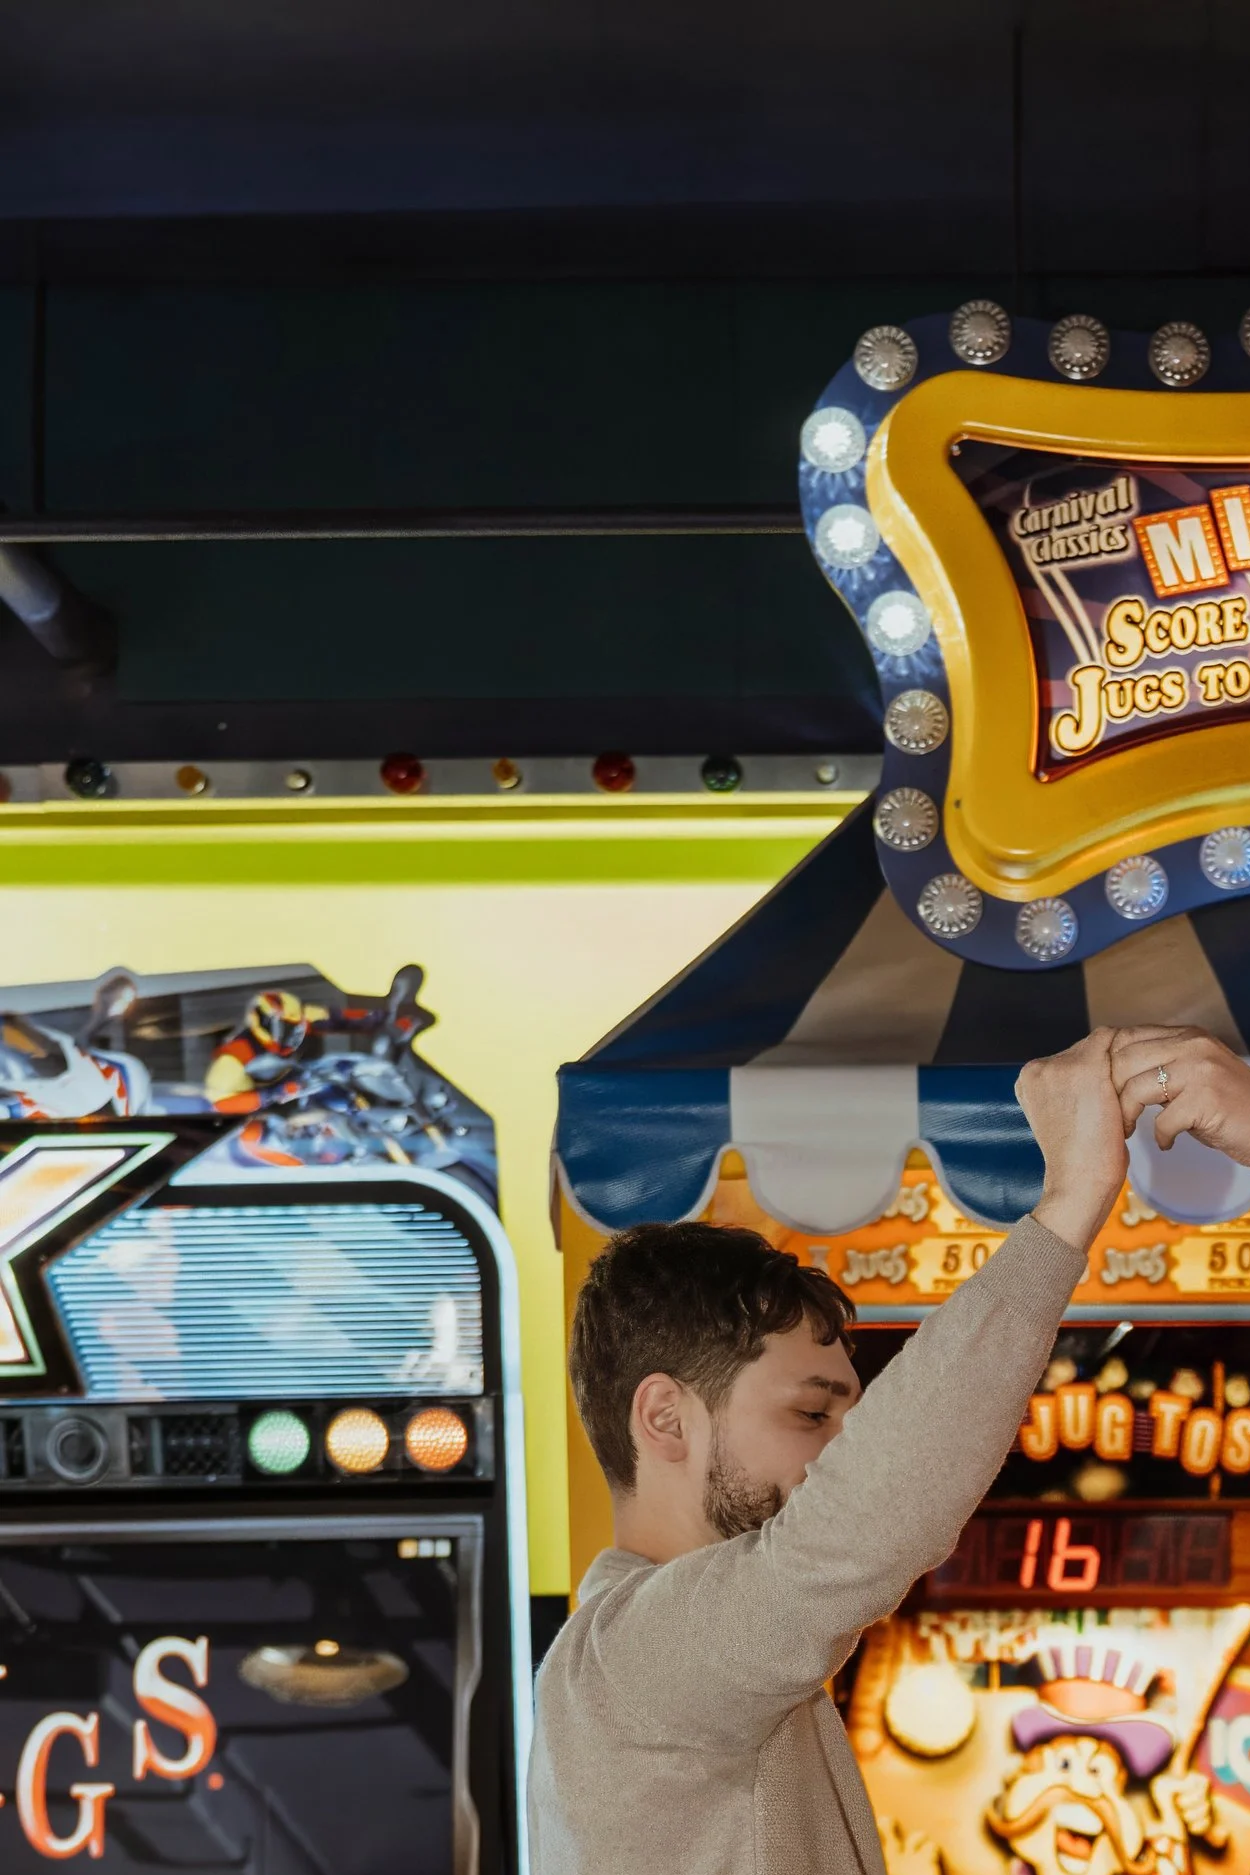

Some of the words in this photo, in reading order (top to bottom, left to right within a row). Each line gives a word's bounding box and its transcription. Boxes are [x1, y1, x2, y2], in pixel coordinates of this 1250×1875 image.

[1013, 476, 1132, 537] Carnival
[1030, 525, 1129, 565] Classics
[843, 1246, 907, 1284] JUGS
[1101, 1244, 1167, 1285] JUGS
[1021, 1384, 1134, 1461] JUG
[1020, 1517, 1100, 1592] 16
